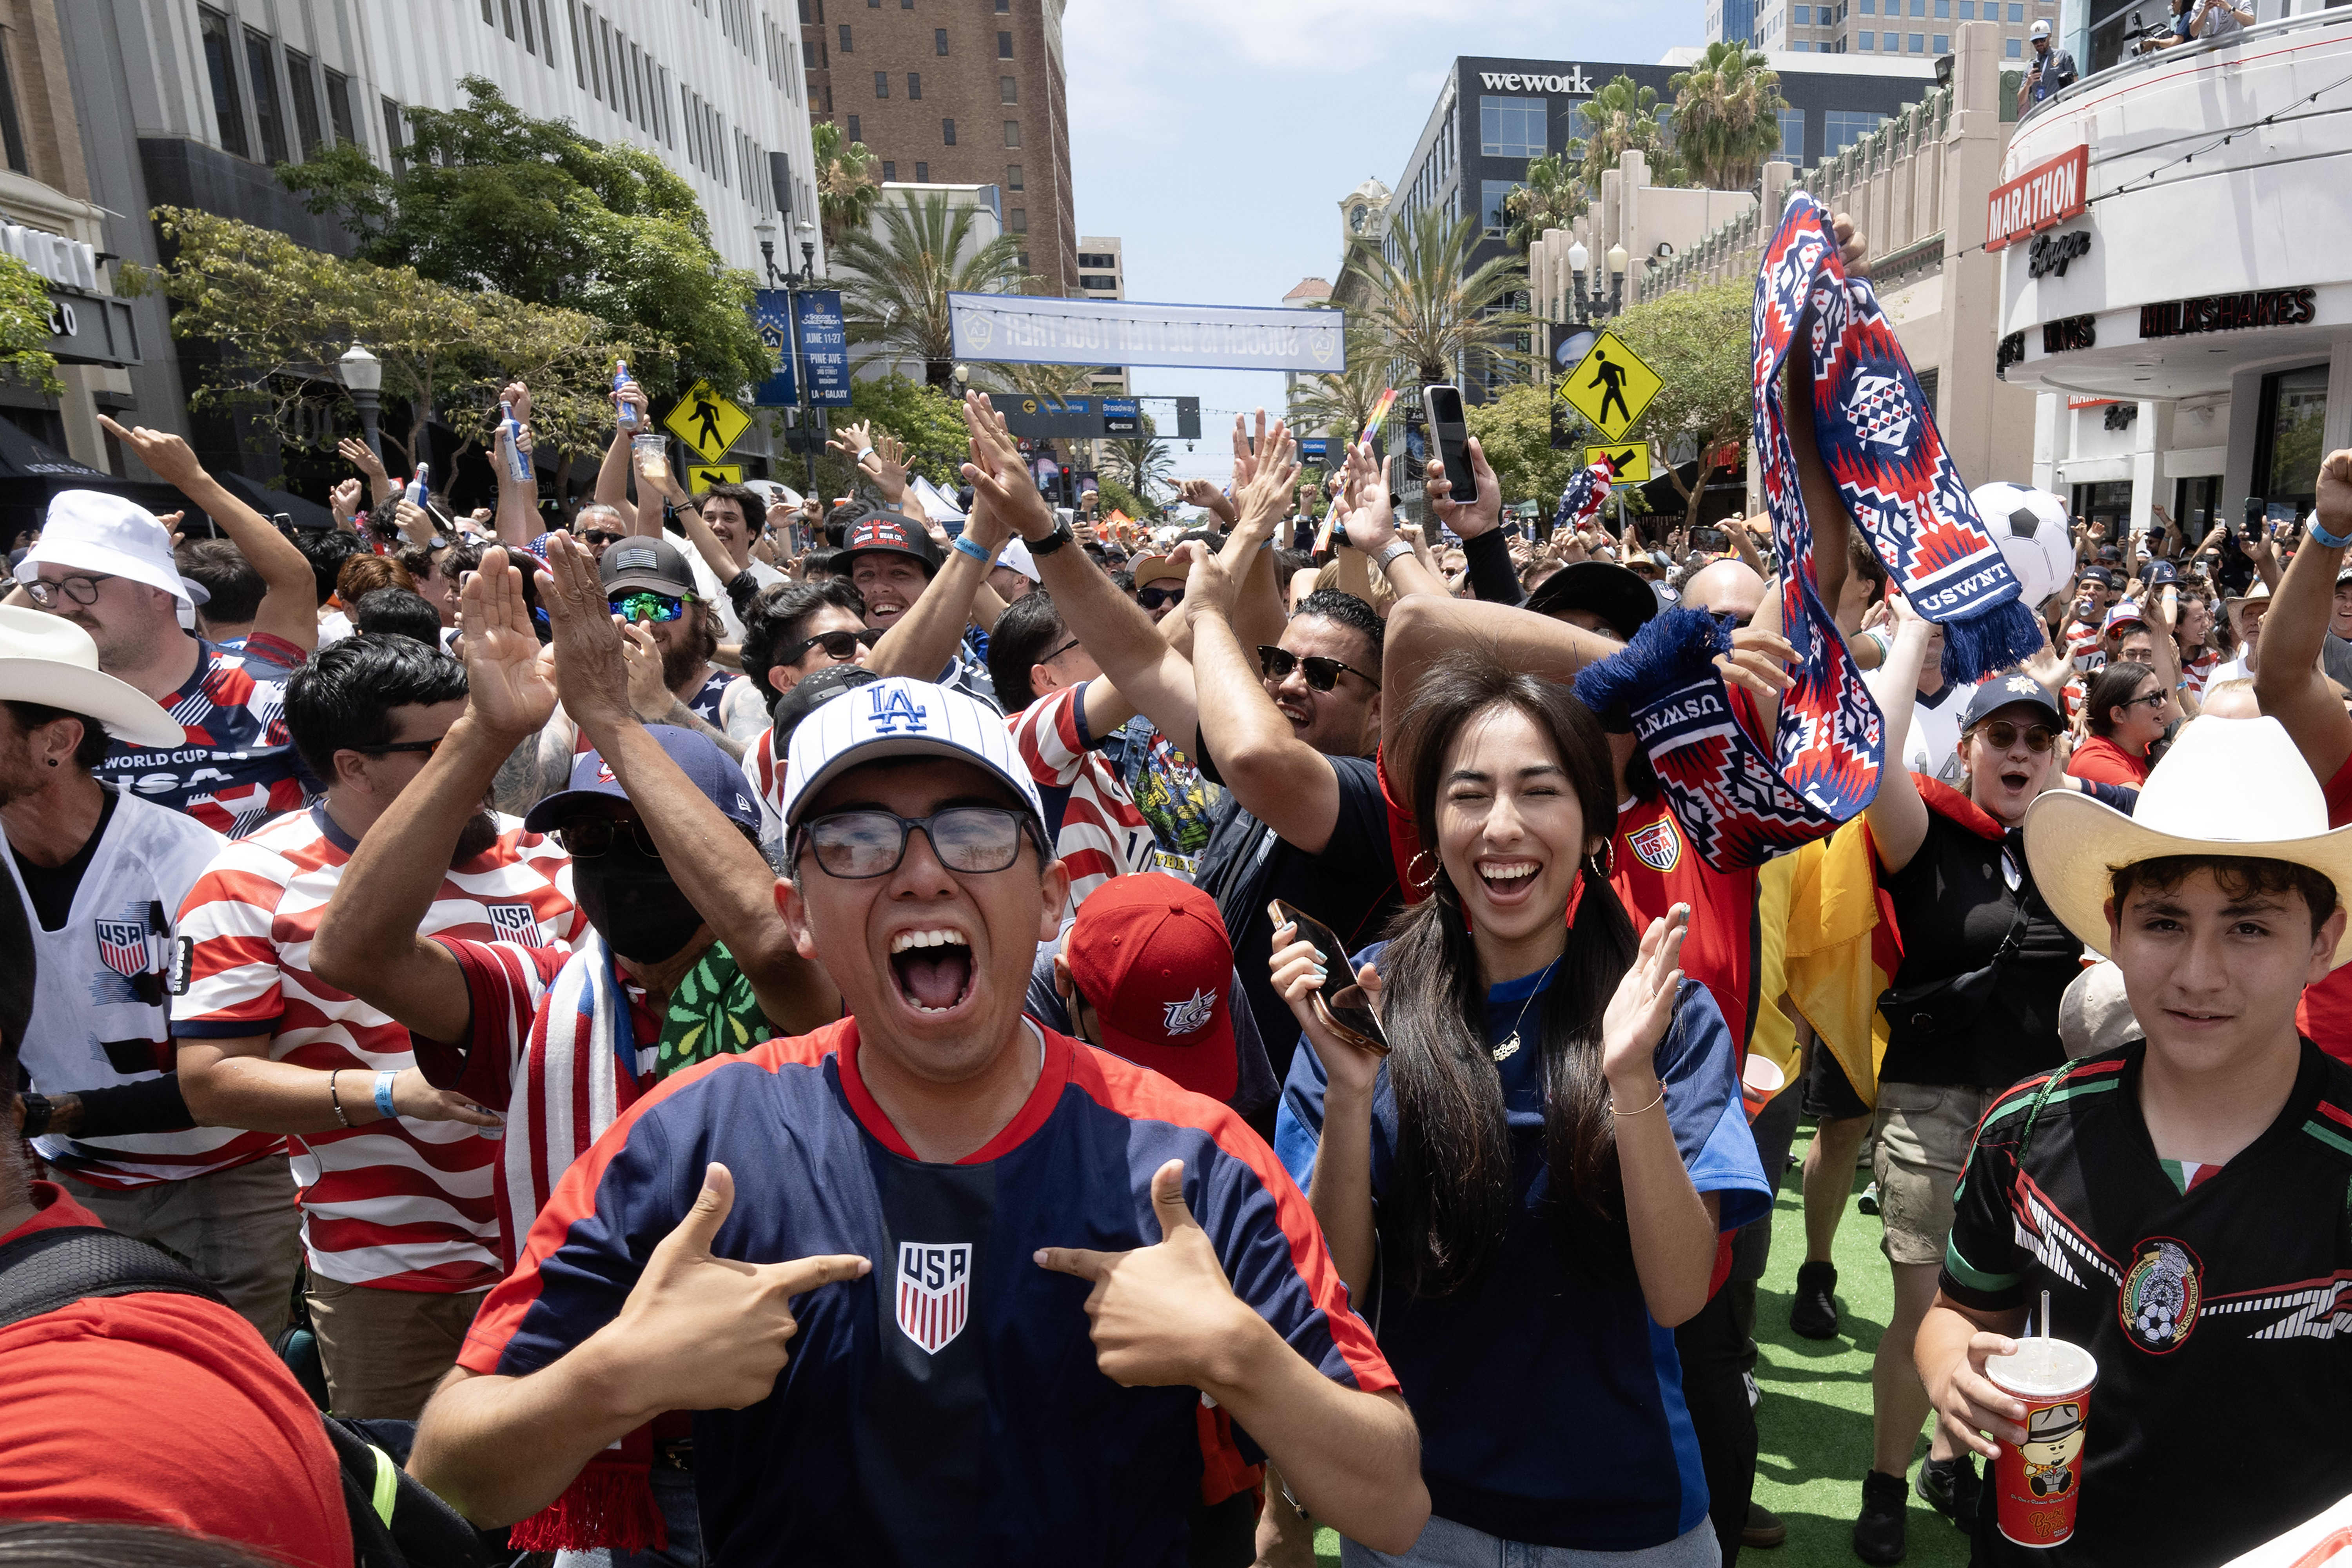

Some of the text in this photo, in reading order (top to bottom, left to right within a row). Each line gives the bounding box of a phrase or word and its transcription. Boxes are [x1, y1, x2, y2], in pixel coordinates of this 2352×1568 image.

[1479, 65, 1594, 94] wework
[1989, 158, 2077, 243] MARATHON
[2028, 230, 2091, 279] Burger
[2139, 289, 2316, 338] MILKSHAKES
[805, 333, 840, 343] JUNE 11-27
[810, 354, 842, 364] PINE AVE
[811, 390, 847, 398] LA GALAXY
[1103, 404, 1136, 413] Broadway
[1919, 562, 2008, 611] USWNT
[868, 684, 927, 733] LA
[1638, 694, 1723, 741] USWNT
[105, 750, 169, 769] WORLD
[172, 749, 207, 764] CUP
[1915, 752, 1961, 782] 14
[1126, 831, 1155, 873] 10
[1642, 838, 1671, 855] USA
[1154, 853, 1185, 871] THE
[494, 907, 531, 928] USA
[99, 923, 140, 946] USA
[904, 1250, 965, 1290] USA
[2029, 1506, 2065, 1528] Baby
[2036, 1517, 2066, 1539] Bros
